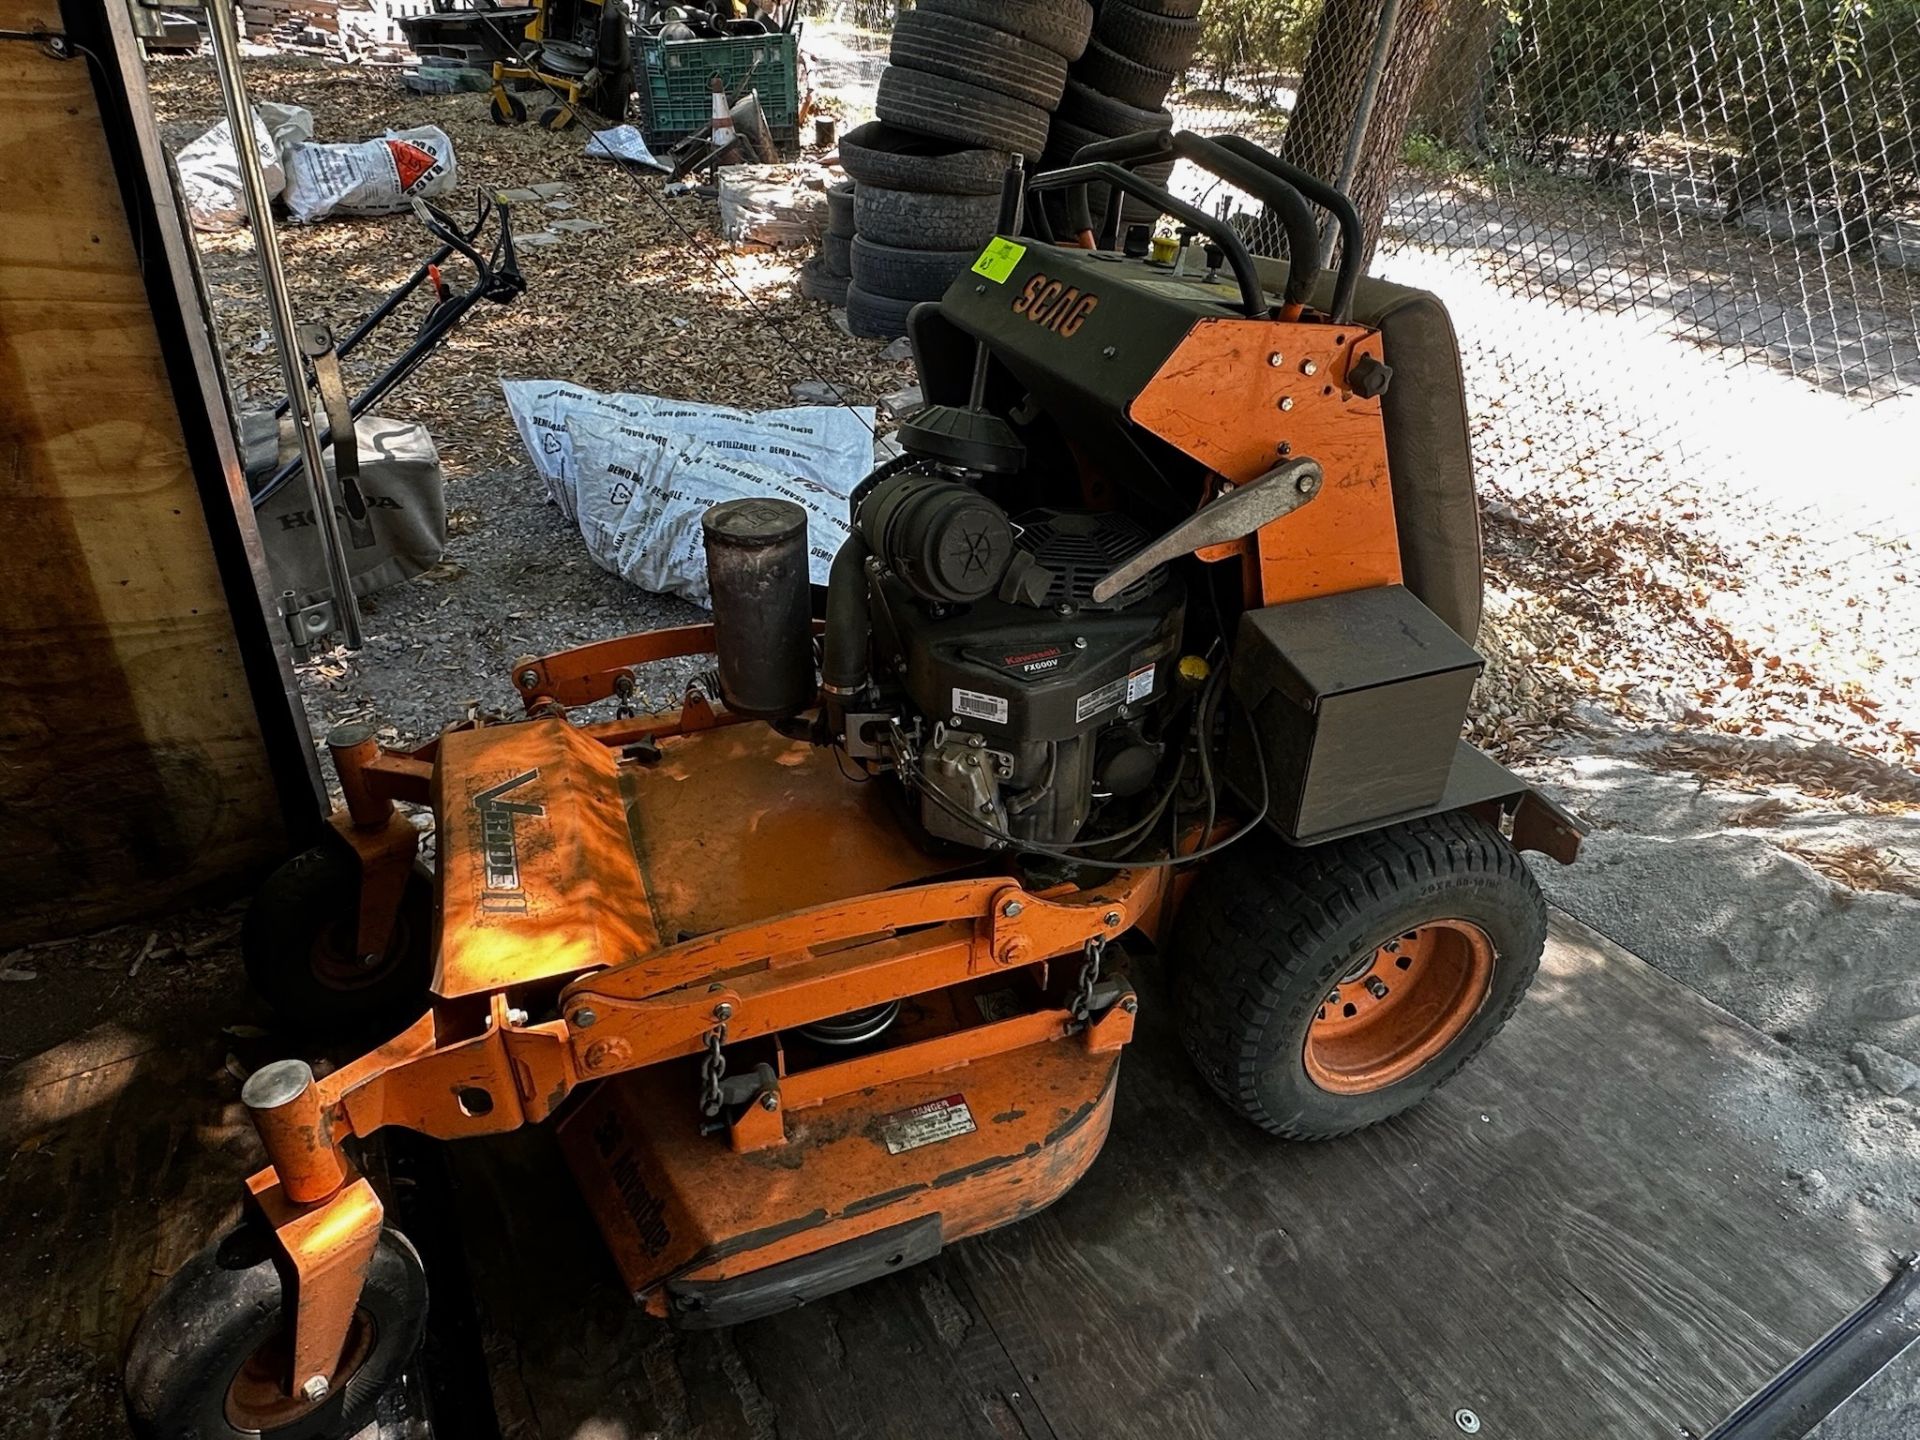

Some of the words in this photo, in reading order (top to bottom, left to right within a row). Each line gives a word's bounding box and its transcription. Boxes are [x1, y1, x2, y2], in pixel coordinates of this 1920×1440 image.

[407, 164, 444, 198] BAGS
[1012, 272, 1099, 338] SCAG
[769, 445, 790, 457] DEMO
[607, 463, 632, 480] DEMO
[738, 469, 763, 484] DEMO
[1004, 647, 1061, 665] Kawasaki
[911, 1100, 950, 1117] DANGER
